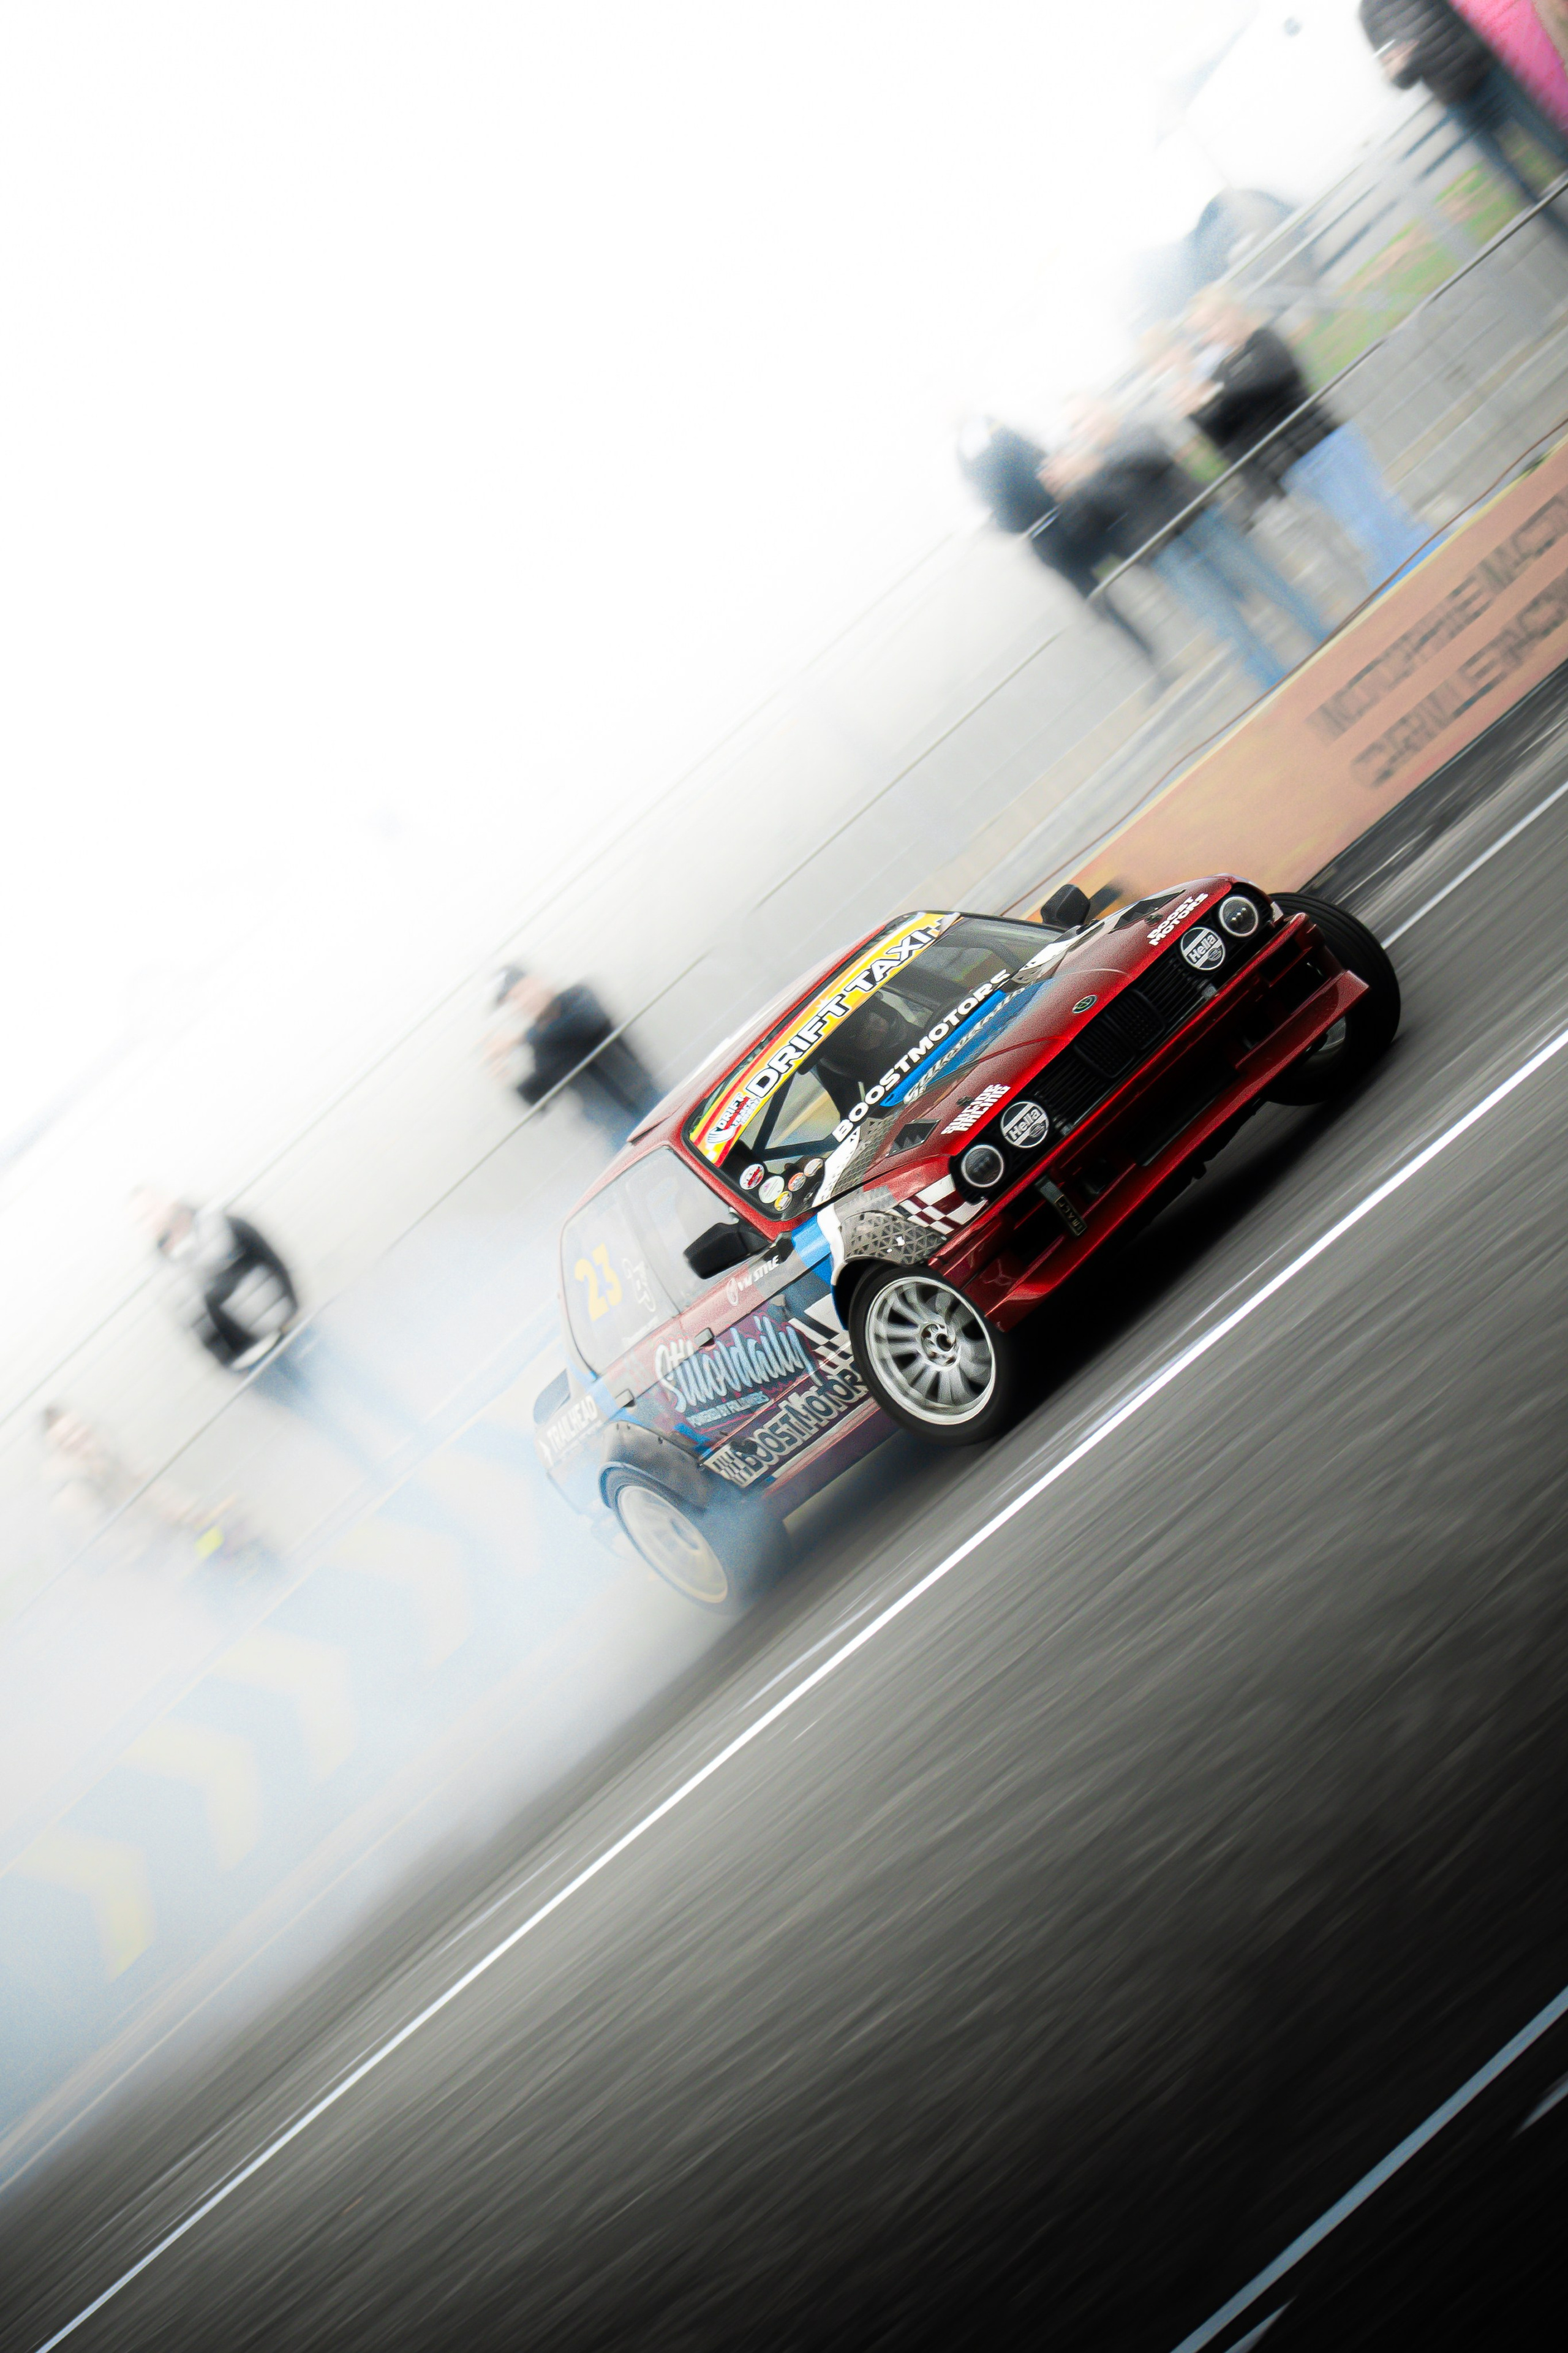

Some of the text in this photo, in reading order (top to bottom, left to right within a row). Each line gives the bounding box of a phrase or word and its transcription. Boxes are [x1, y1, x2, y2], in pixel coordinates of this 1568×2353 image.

[1146, 896, 1194, 937] BOOST
[1148, 893, 1208, 945] MOTORS
[1188, 934, 1216, 962] Hella
[747, 929, 930, 1099] DRIFT TAXI
[832, 969, 1011, 1143] BOOSTMOTORS
[717, 1093, 745, 1129] DRIFT
[940, 1084, 1001, 1135] SUICIDE
[954, 1086, 1011, 1131] RACING
[1007, 1108, 1041, 1139] Hella
[576, 1244, 621, 1321] 23
[734, 1365, 867, 1475] BOOSTMOTOR
